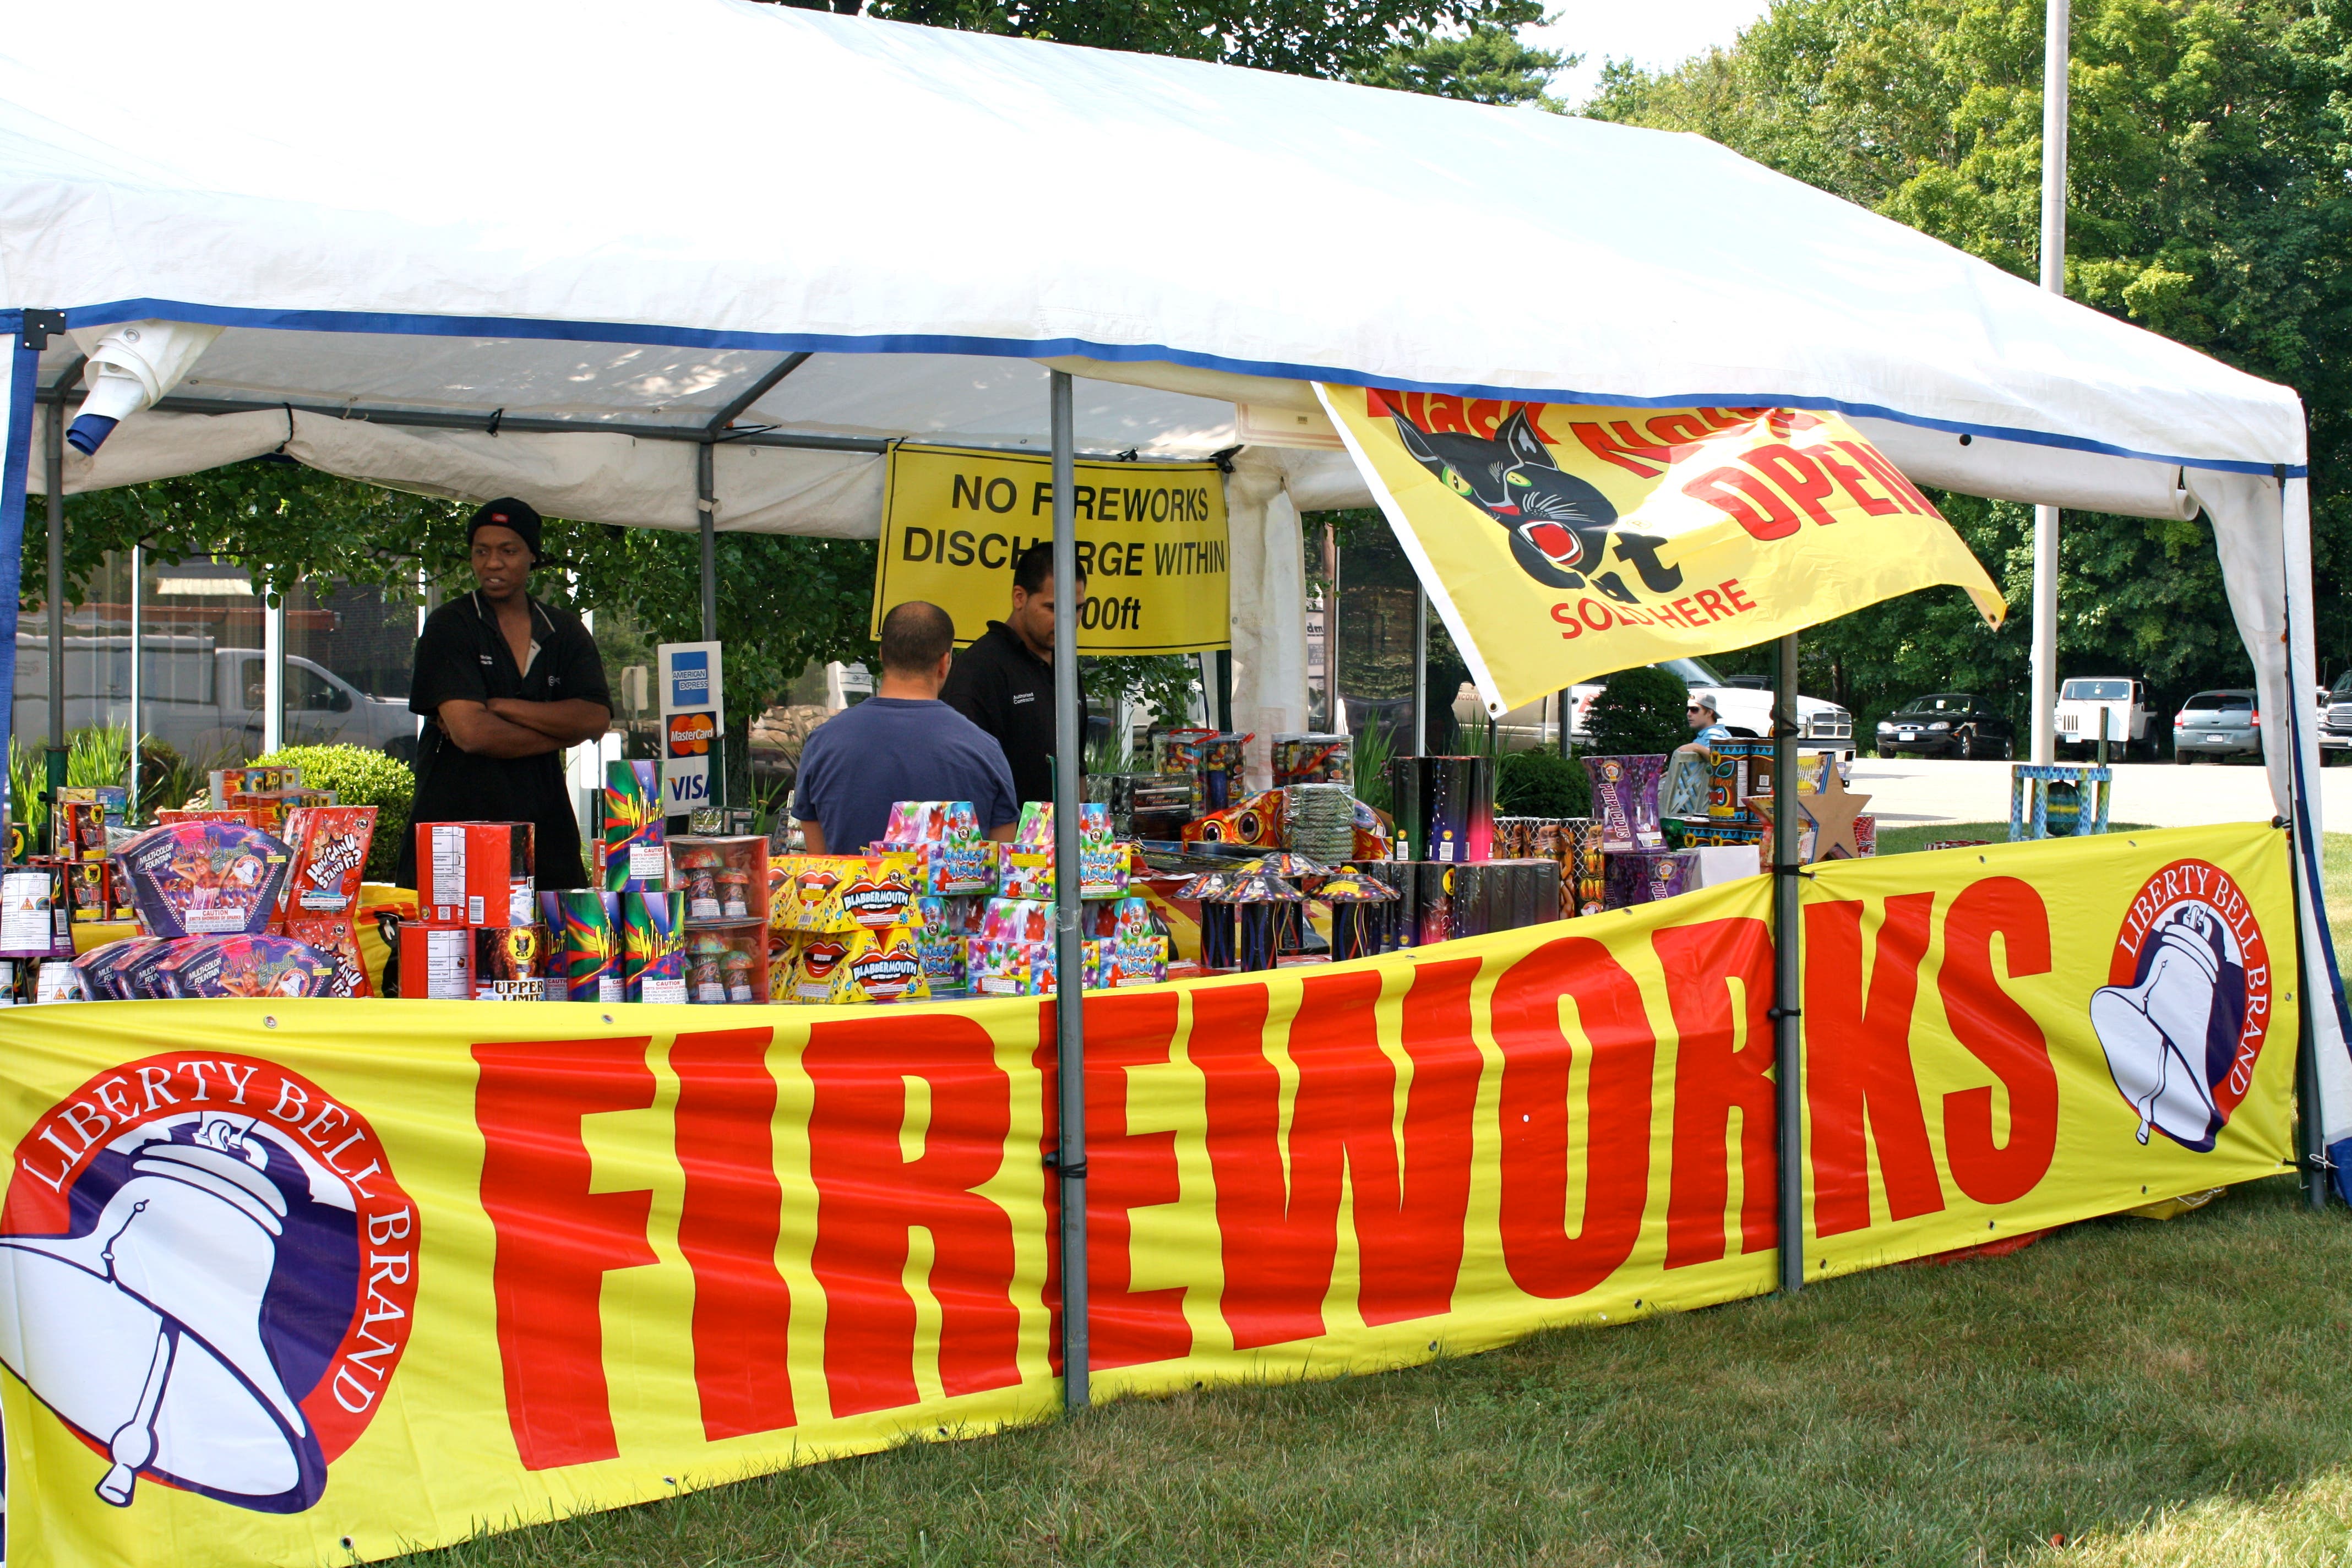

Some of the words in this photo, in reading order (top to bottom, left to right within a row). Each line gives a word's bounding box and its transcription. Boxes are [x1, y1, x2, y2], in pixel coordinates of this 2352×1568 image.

[952, 473, 1017, 514] NO
[1032, 481, 1208, 523] FREWORKS
[1682, 440, 1946, 541] OPEN
[902, 526, 1145, 577] DISCHRGE
[1155, 540, 1225, 576] WITHIN
[1082, 596, 1141, 630] 00ft
[1550, 597, 1655, 640] SOLD
[1645, 578, 1758, 628] HERE
[672, 671, 706, 679] AMERICAN
[680, 680, 709, 689] EXPRESS
[670, 727, 714, 742] MasterCard
[1598, 783, 1631, 839] PURPLICIOUS
[139, 842, 174, 865] MULTI-COLOR
[145, 851, 172, 870] FOUNTAIN
[176, 832, 220, 865] SHOW
[306, 855, 329, 881] HOW
[325, 840, 346, 862] CAN
[343, 833, 356, 851] U
[318, 862, 344, 889] STAND
[342, 849, 363, 870] IT?
[843, 890, 910, 912] BLABBERMOUTH
[2119, 864, 2211, 958] LIBERTY
[2212, 874, 2258, 960] BELL
[188, 958, 222, 981] MULTI-COLOR
[194, 967, 220, 986] FOUNTAIN
[224, 946, 268, 979] SHOW
[853, 960, 918, 982] BLABBERMOUTH
[494, 980, 545, 994] UPPER
[2229, 963, 2267, 1096] BRAND
[472, 874, 2059, 1471] FIREWORKS
[22, 1059, 259, 1193] LIBERTY
[268, 1077, 382, 1199] BELL
[333, 1205, 410, 1414] BRAND
